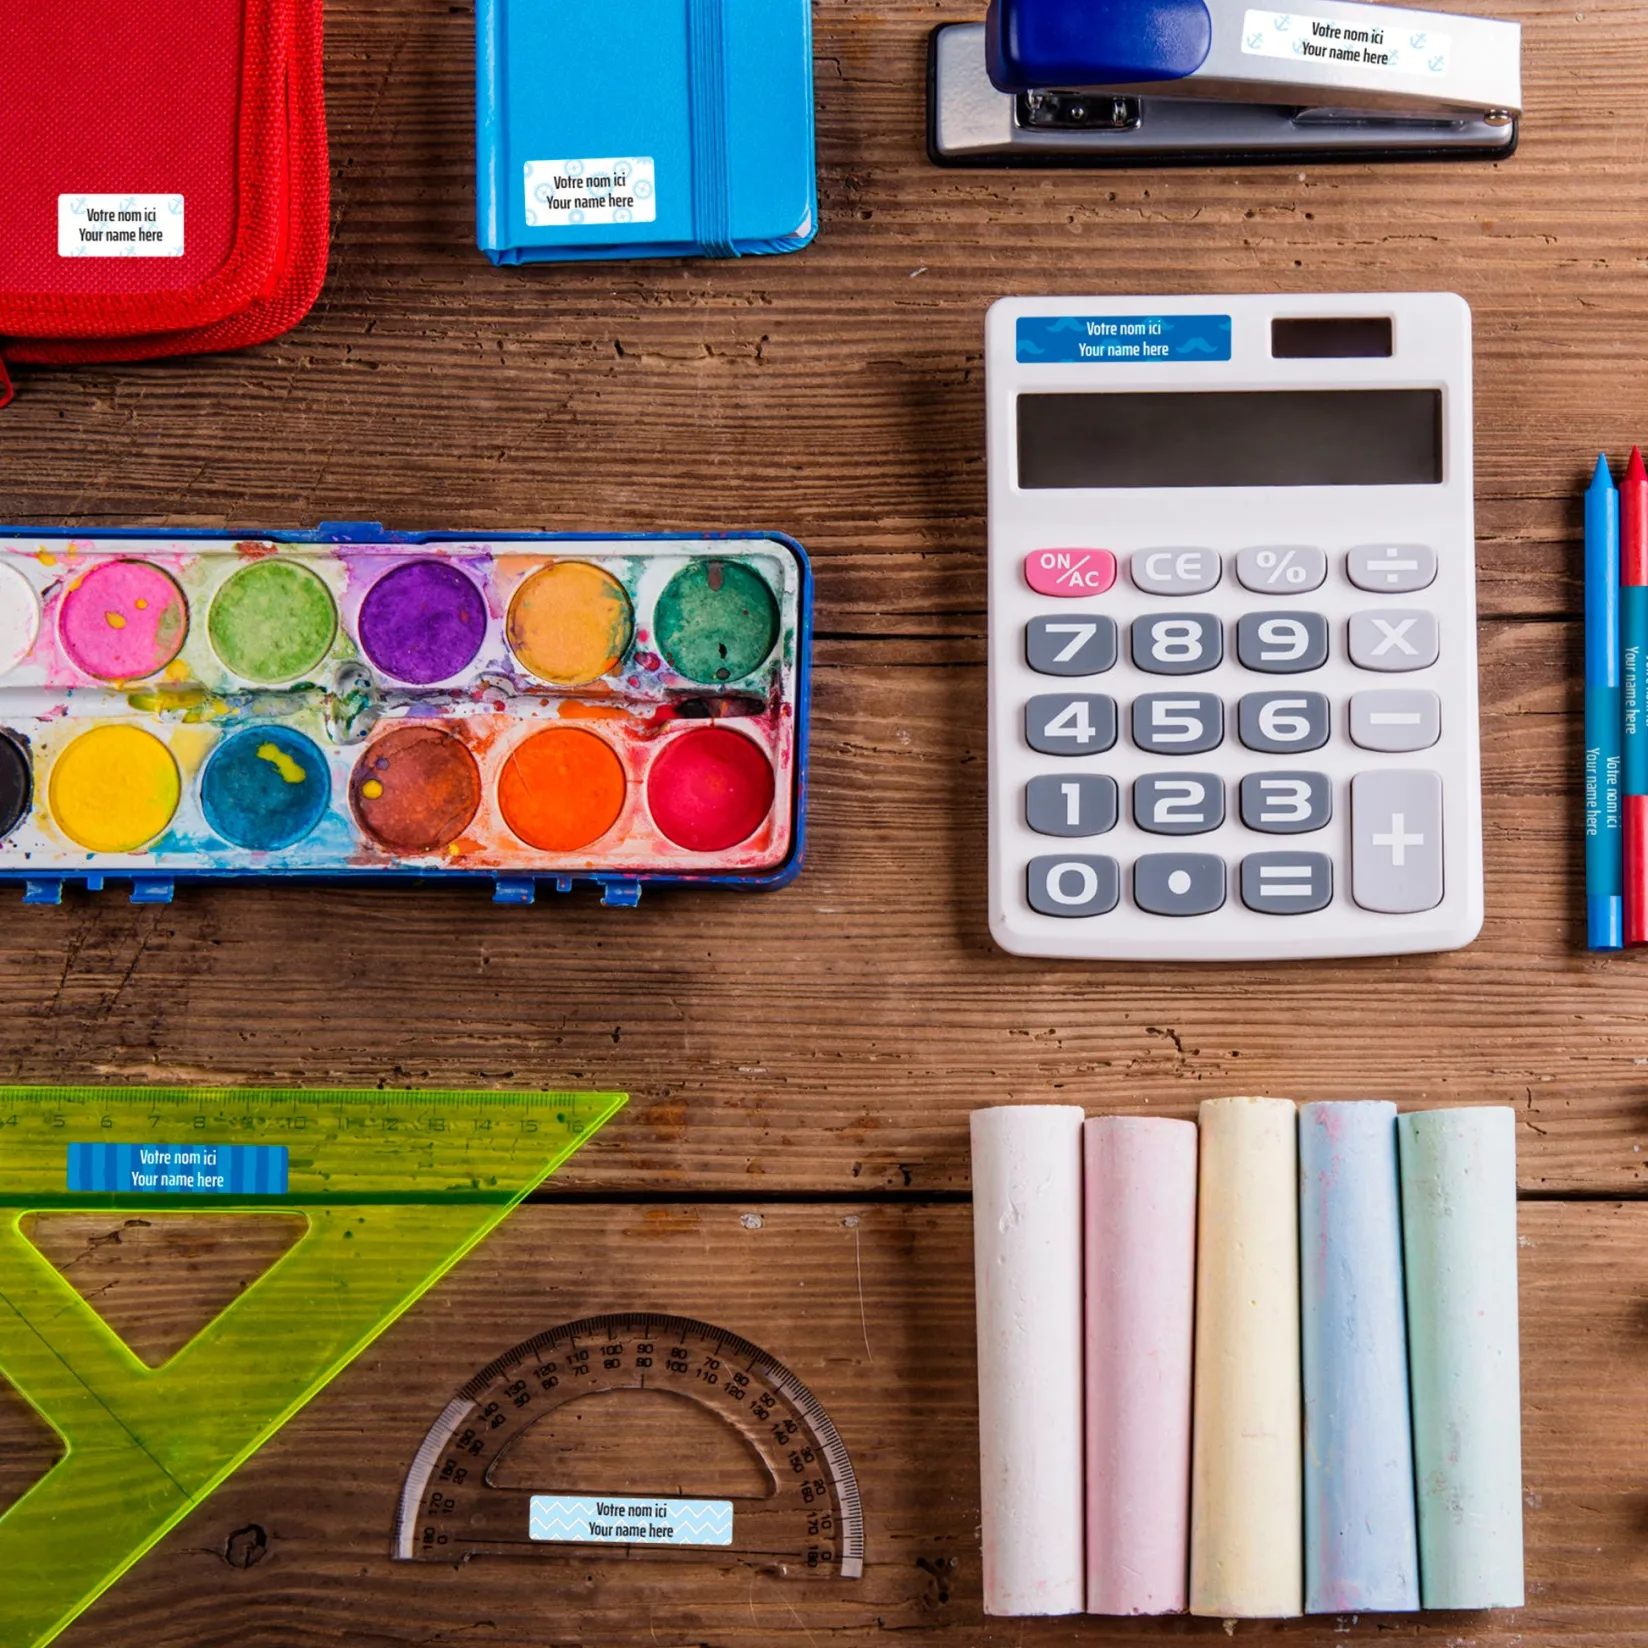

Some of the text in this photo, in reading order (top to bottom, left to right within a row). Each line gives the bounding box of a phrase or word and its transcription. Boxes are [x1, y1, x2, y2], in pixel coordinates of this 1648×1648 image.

[1312, 22, 1384, 44] Votre nom ici
[1303, 41, 1388, 65] Your name here
[554, 172, 626, 189] Votre nom ici
[547, 193, 634, 209] Your name here
[87, 207, 156, 221] Votre nom ici
[79, 227, 163, 241] Your name here
[1086, 320, 1161, 336] Votre nom ici
[1078, 341, 1169, 356] Your name here
[1145, 553, 1201, 580] CE
[1256, 551, 1307, 584] %
[1045, 623, 1097, 662] 7
[1152, 620, 1203, 662] 8
[1257, 619, 1309, 660] 9
[1625, 646, 1640, 734] Your name here
[1043, 701, 1096, 743] 4
[1152, 701, 1203, 742] 5
[1259, 699, 1311, 741] 6
[1586, 748, 1601, 836] Your name here
[1606, 756, 1622, 828] Votre nom ici
[1061, 783, 1080, 825] 1
[1154, 780, 1205, 823] 2
[1260, 780, 1312, 822] 3
[1046, 862, 1097, 905] 0
[6, 1114, 19, 1127] 4
[53, 1115, 65, 1128] 5
[101, 1115, 113, 1128] 6
[147, 1116, 160, 1128] 7
[194, 1116, 206, 1129] 8
[287, 1116, 306, 1129] 10
[382, 1118, 399, 1131] 12
[428, 1118, 445, 1132] 13
[473, 1119, 492, 1132] 14
[520, 1119, 538, 1132] 15
[566, 1120, 584, 1133] 16
[140, 1149, 216, 1165] Votre nom ici
[131, 1171, 224, 1187] Your name here
[566, 1350, 589, 1364] 110
[600, 1344, 623, 1356] 100
[637, 1344, 653, 1354] 90
[533, 1362, 557, 1378] 120
[572, 1364, 589, 1377] 70
[635, 1357, 652, 1368] 90
[666, 1360, 688, 1373] 100
[704, 1356, 720, 1370] 70
[696, 1368, 718, 1384] 110
[504, 1380, 526, 1398] 130
[724, 1382, 746, 1400] 120
[749, 1401, 769, 1420] 130
[453, 1468, 467, 1485] 20
[814, 1479, 826, 1495] 20
[428, 1492, 443, 1515] 170
[442, 1499, 455, 1514] 10
[596, 1502, 667, 1518] Votre nom ici
[589, 1522, 673, 1538] Your name here
[807, 1512, 818, 1535] 170
[821, 1514, 832, 1529] 10
[437, 1535, 448, 1545] 0
[821, 1551, 832, 1560] 0
